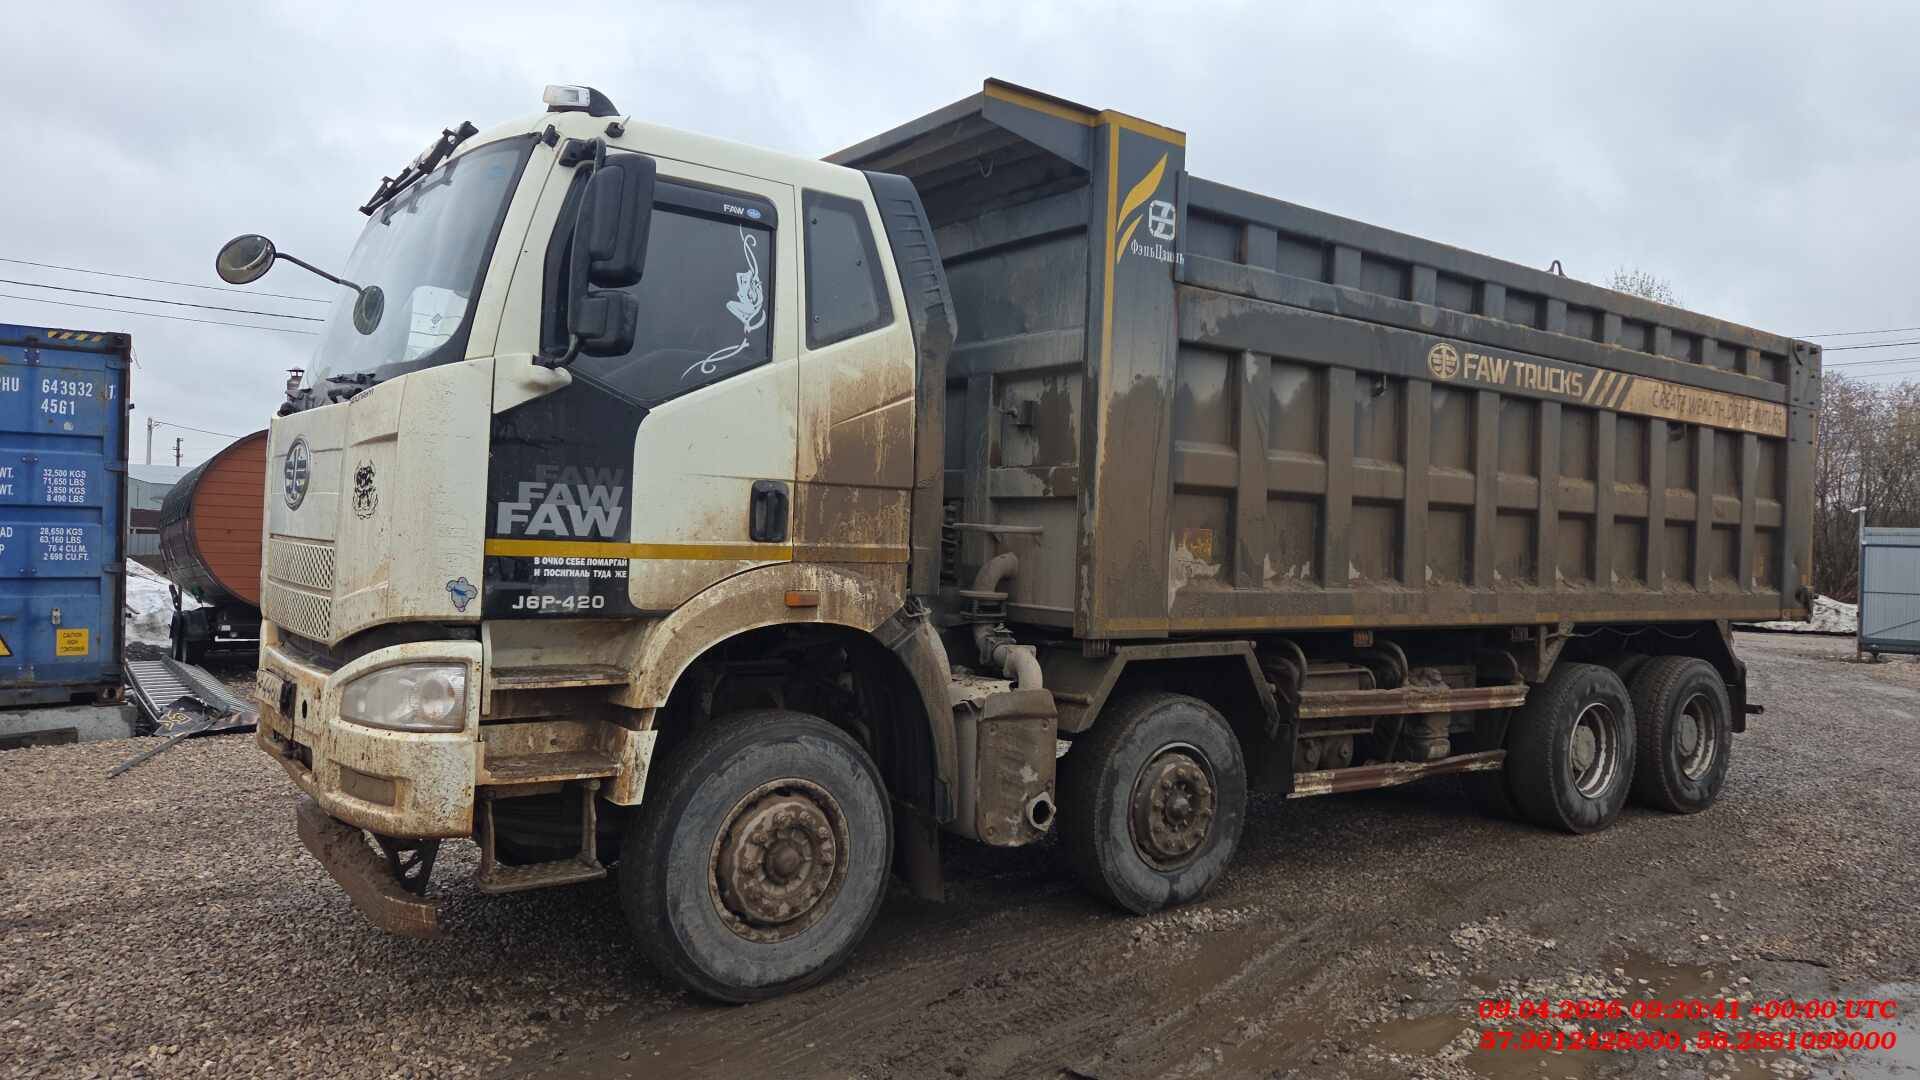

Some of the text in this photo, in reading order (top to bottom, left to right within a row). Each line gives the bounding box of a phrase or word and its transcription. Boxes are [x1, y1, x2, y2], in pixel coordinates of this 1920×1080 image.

[723, 203, 745, 215] FAW
[1463, 352, 1584, 397] FAW TRUCKS
[0, 376, 19, 392] HU
[42, 379, 93, 397] 643932
[41, 398, 75, 415] 45G1
[69, 470, 87, 479] KGS
[535, 464, 624, 486] FAW
[69, 478, 85, 487] LBS
[68, 486, 86, 495] KGS
[68, 495, 84, 503] LBS
[518, 481, 624, 512] FAW
[497, 501, 623, 537] FAW
[66, 528, 83, 536] KGS
[66, 536, 82, 544] LBS
[533, 557, 540, 565] В
[542, 557, 564, 566] ОЧКО
[565, 558, 586, 566] СЕБЕ
[533, 568, 628, 579] И ПОСИГНАЛЬ ТУДА ЖЕ
[512, 595, 605, 609] J6P-420
